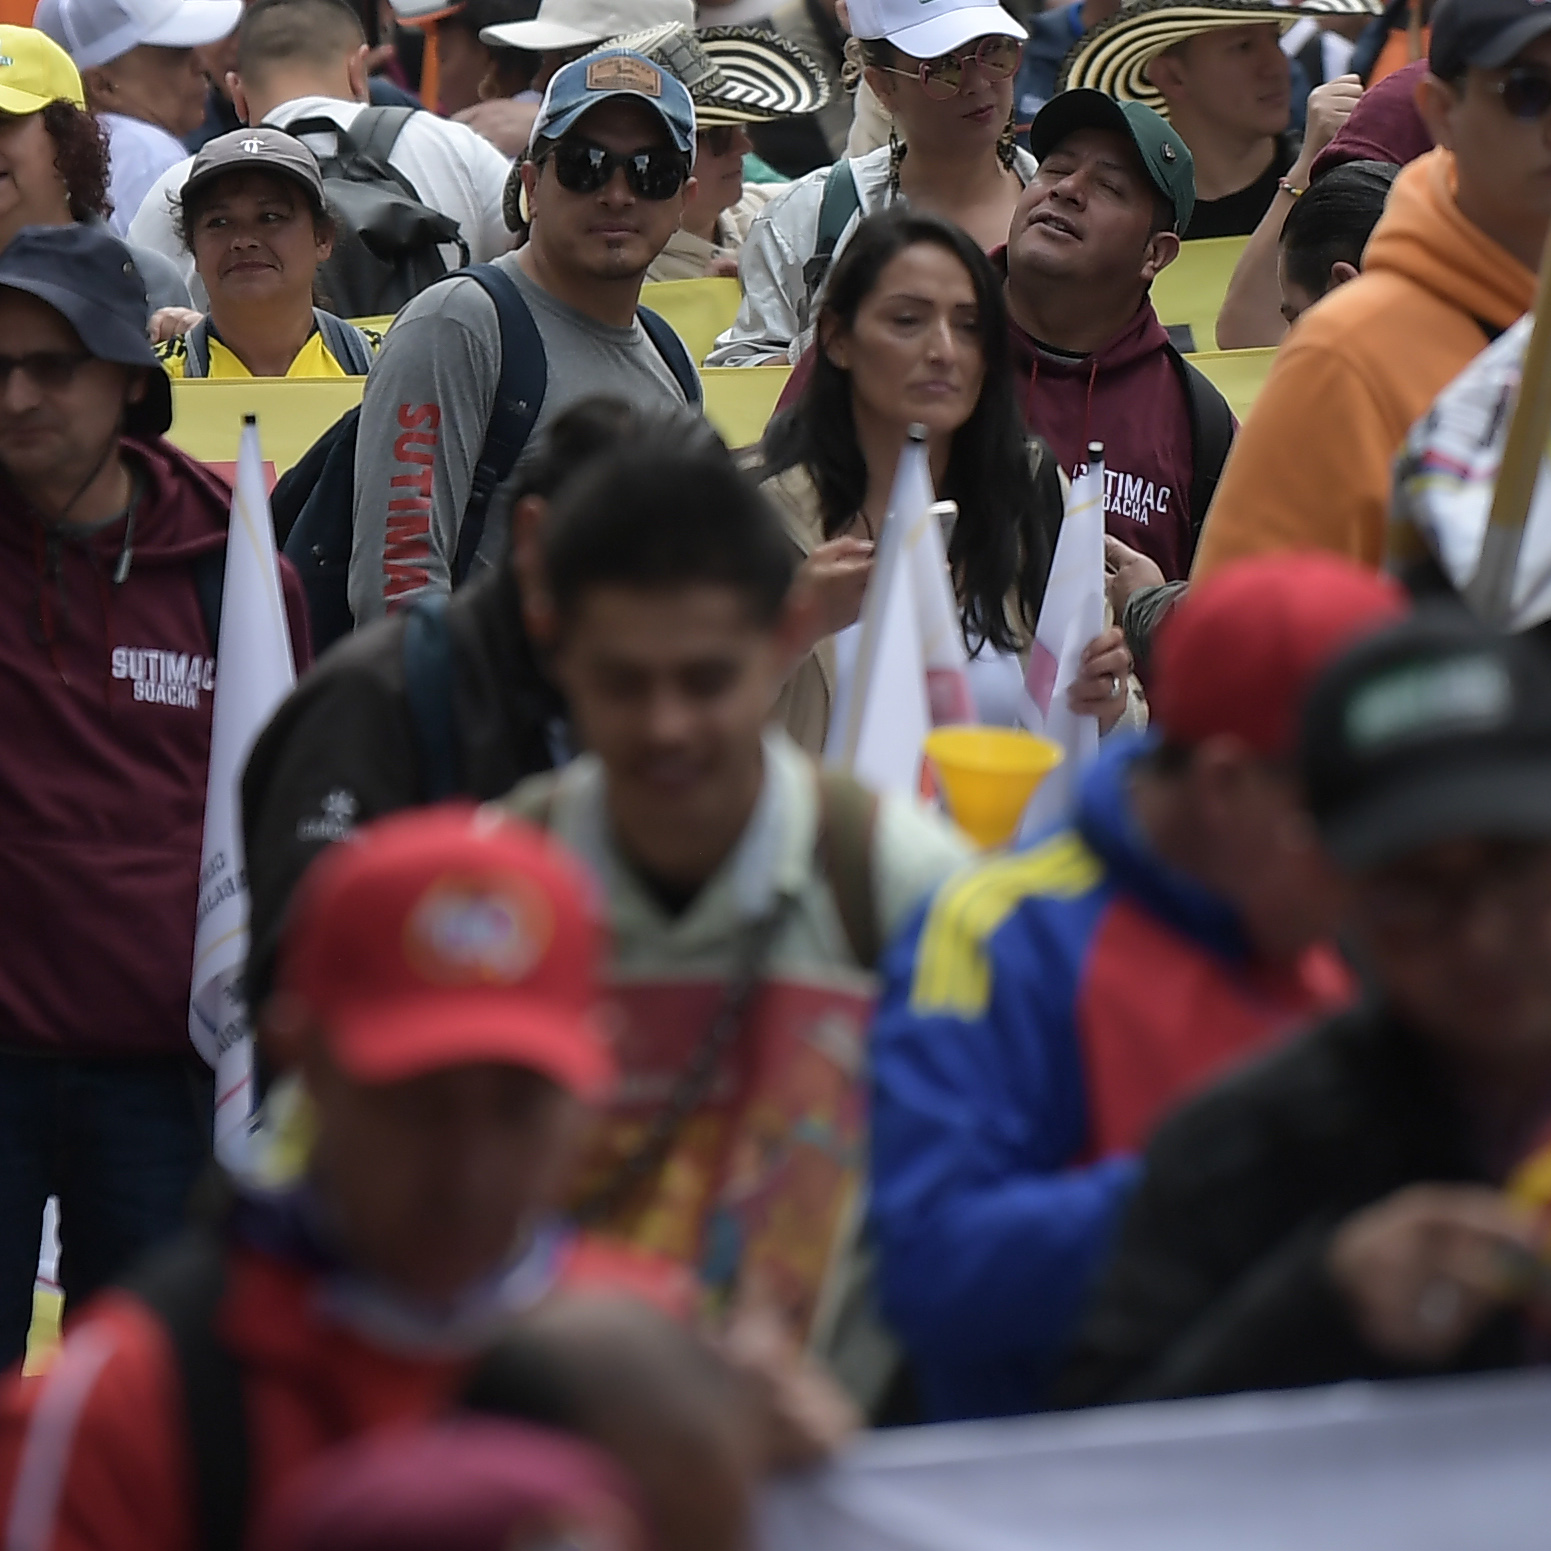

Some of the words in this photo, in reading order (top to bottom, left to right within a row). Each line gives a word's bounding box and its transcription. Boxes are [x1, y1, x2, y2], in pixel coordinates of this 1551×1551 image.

[1103, 494, 1149, 526] OACHA
[112, 647, 216, 690] SUTIMAC
[134, 681, 198, 709] SOACHA
